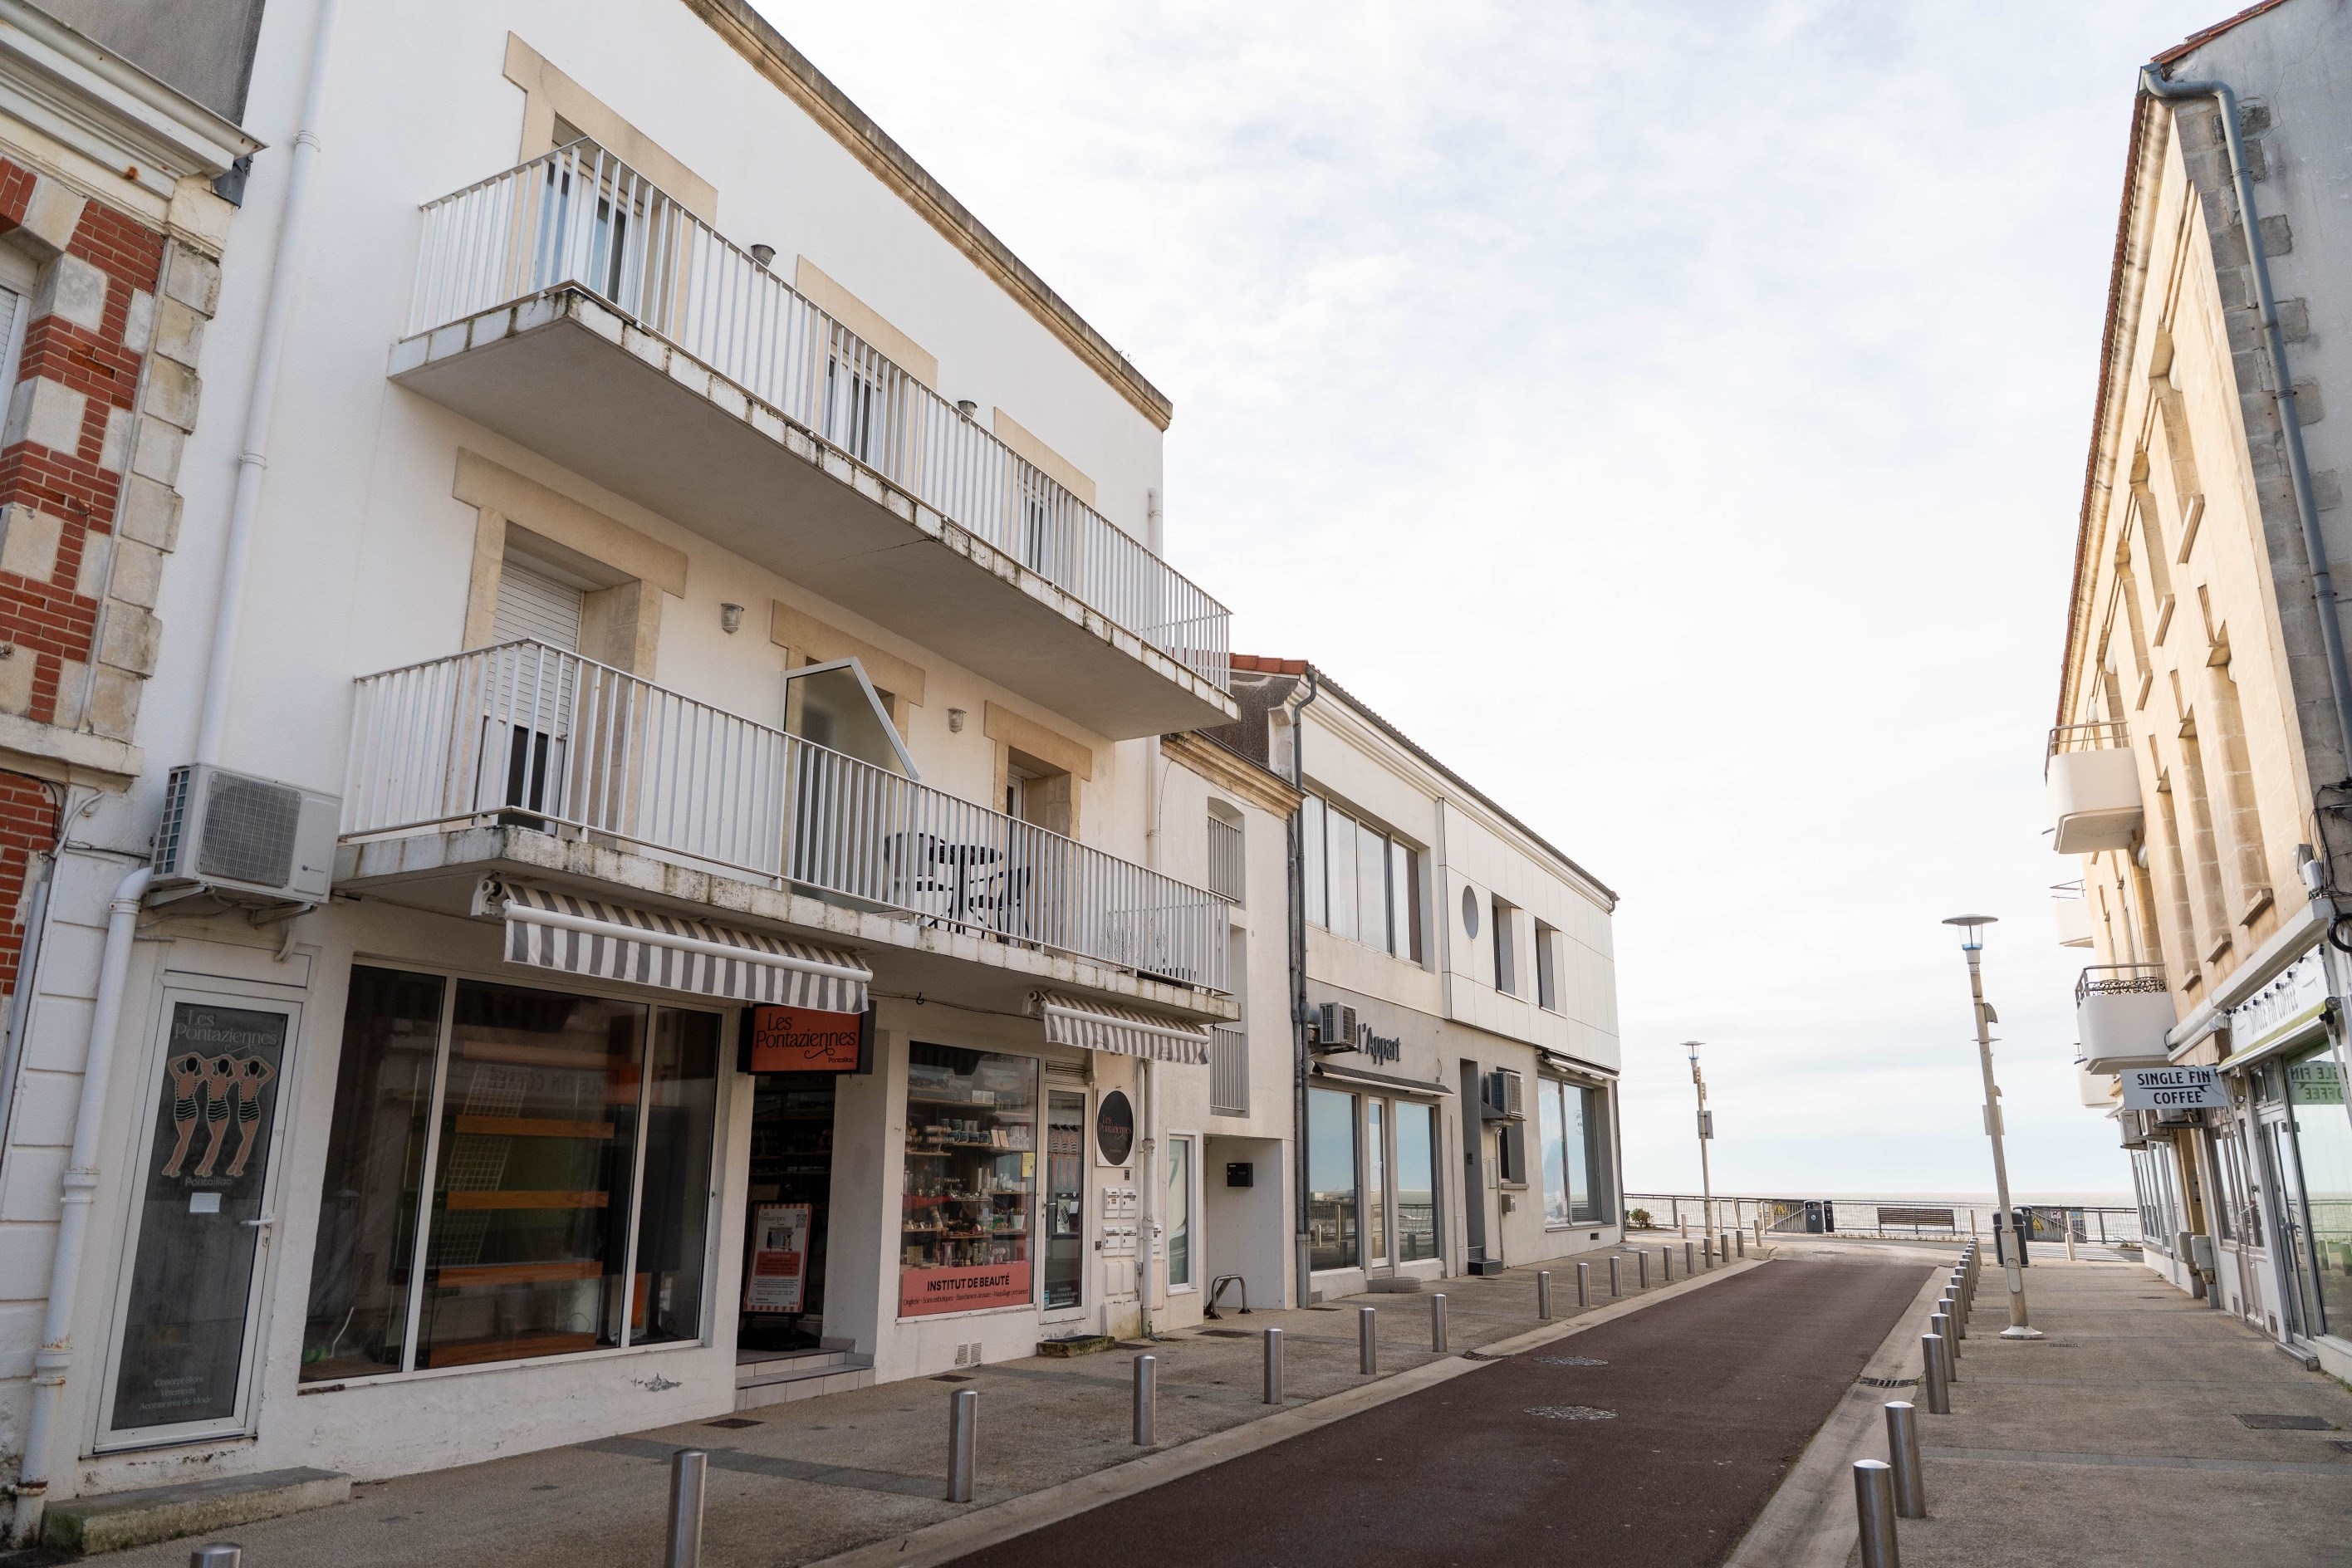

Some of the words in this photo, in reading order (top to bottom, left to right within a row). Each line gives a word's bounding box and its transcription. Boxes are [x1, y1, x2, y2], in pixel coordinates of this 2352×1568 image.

[188, 1009, 215, 1027] Les
[767, 1012, 792, 1031] Les
[174, 1022, 278, 1052] Pontaziennes
[756, 1028, 856, 1060] Pontaziennes
[1357, 1022, 1401, 1066] L'Appart
[2137, 1071, 2183, 1085] SINGLE
[2188, 1071, 2211, 1083] FIN
[2154, 1090, 2203, 1105] COFFEE
[185, 1176, 233, 1187] Pontaillac
[927, 1279, 966, 1291] INSTITUT
[968, 1277, 978, 1288] DE
[979, 1272, 1010, 1287] BEAUTÉ
